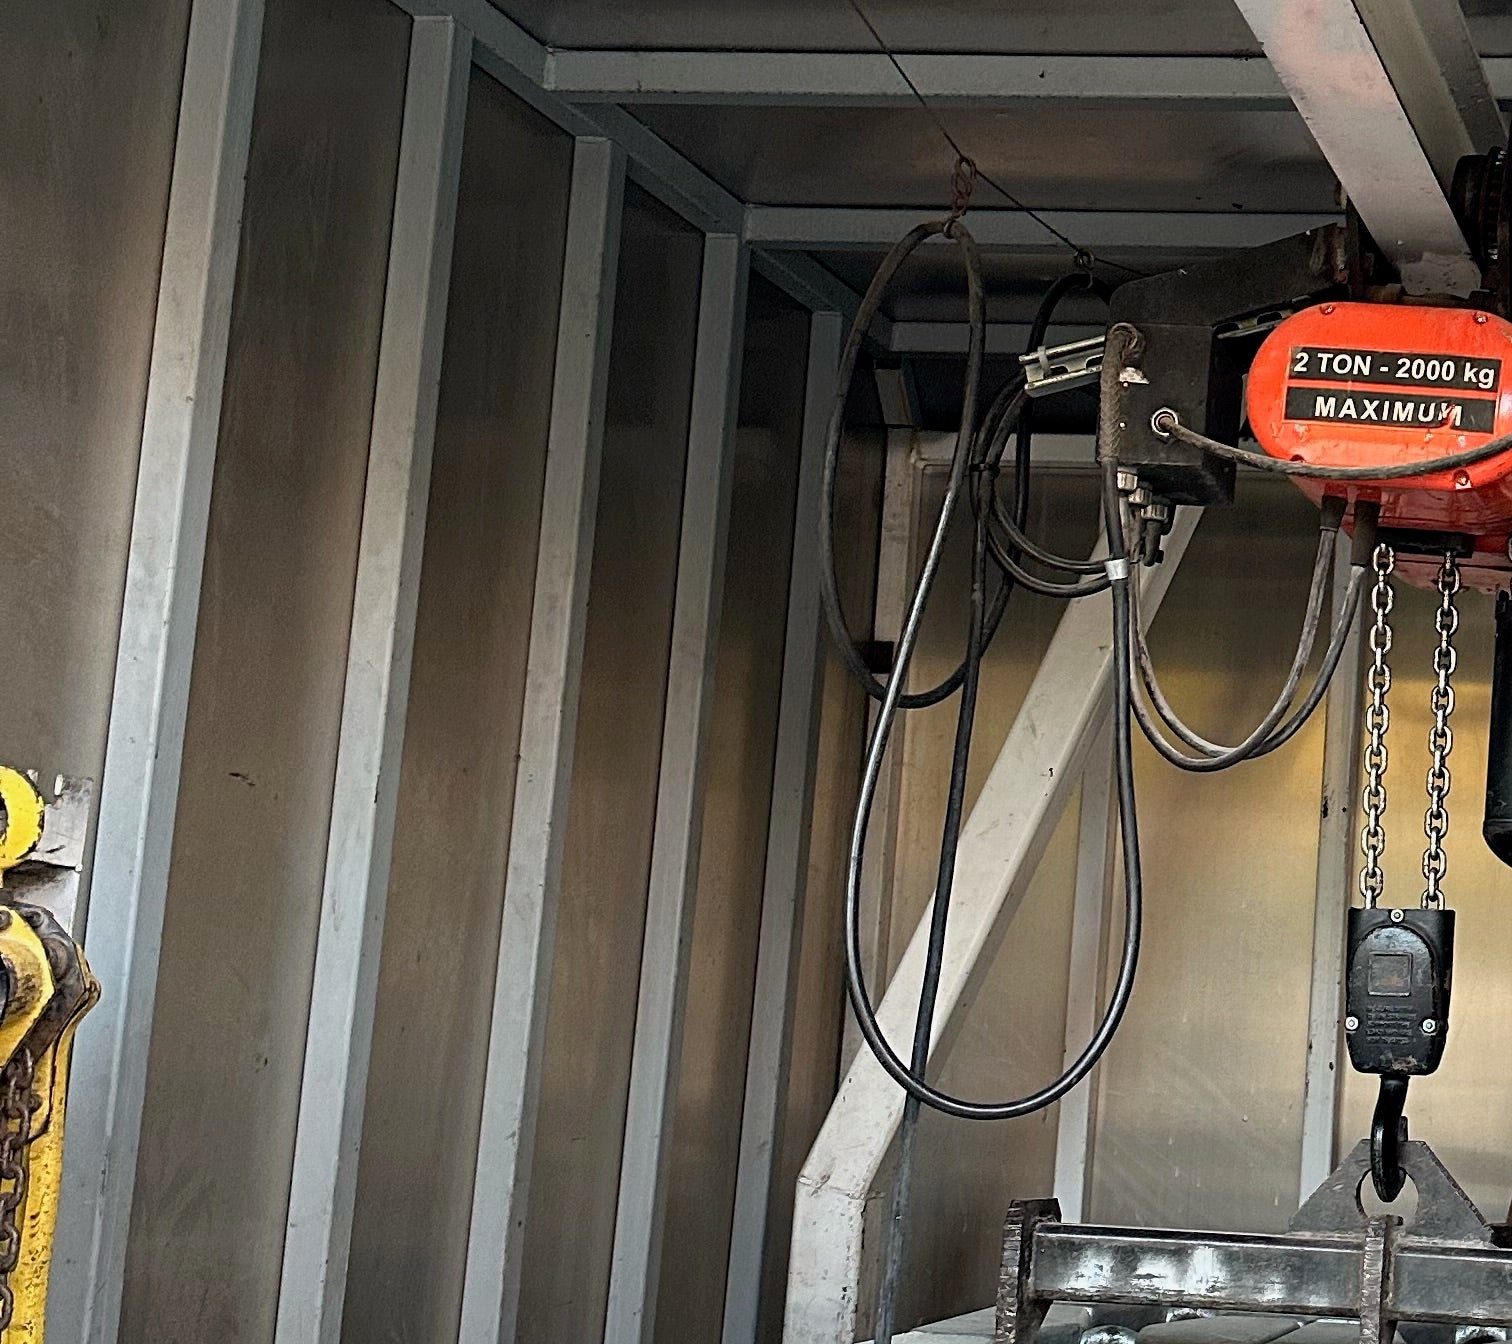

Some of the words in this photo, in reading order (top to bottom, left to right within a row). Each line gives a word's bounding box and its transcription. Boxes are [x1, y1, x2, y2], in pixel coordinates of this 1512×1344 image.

[1293, 352, 1309, 372] 2
[1317, 353, 1372, 376] TON
[1395, 358, 1455, 381] 2000
[1463, 362, 1495, 389] kg
[1314, 396, 1463, 426] MAXIMUM
